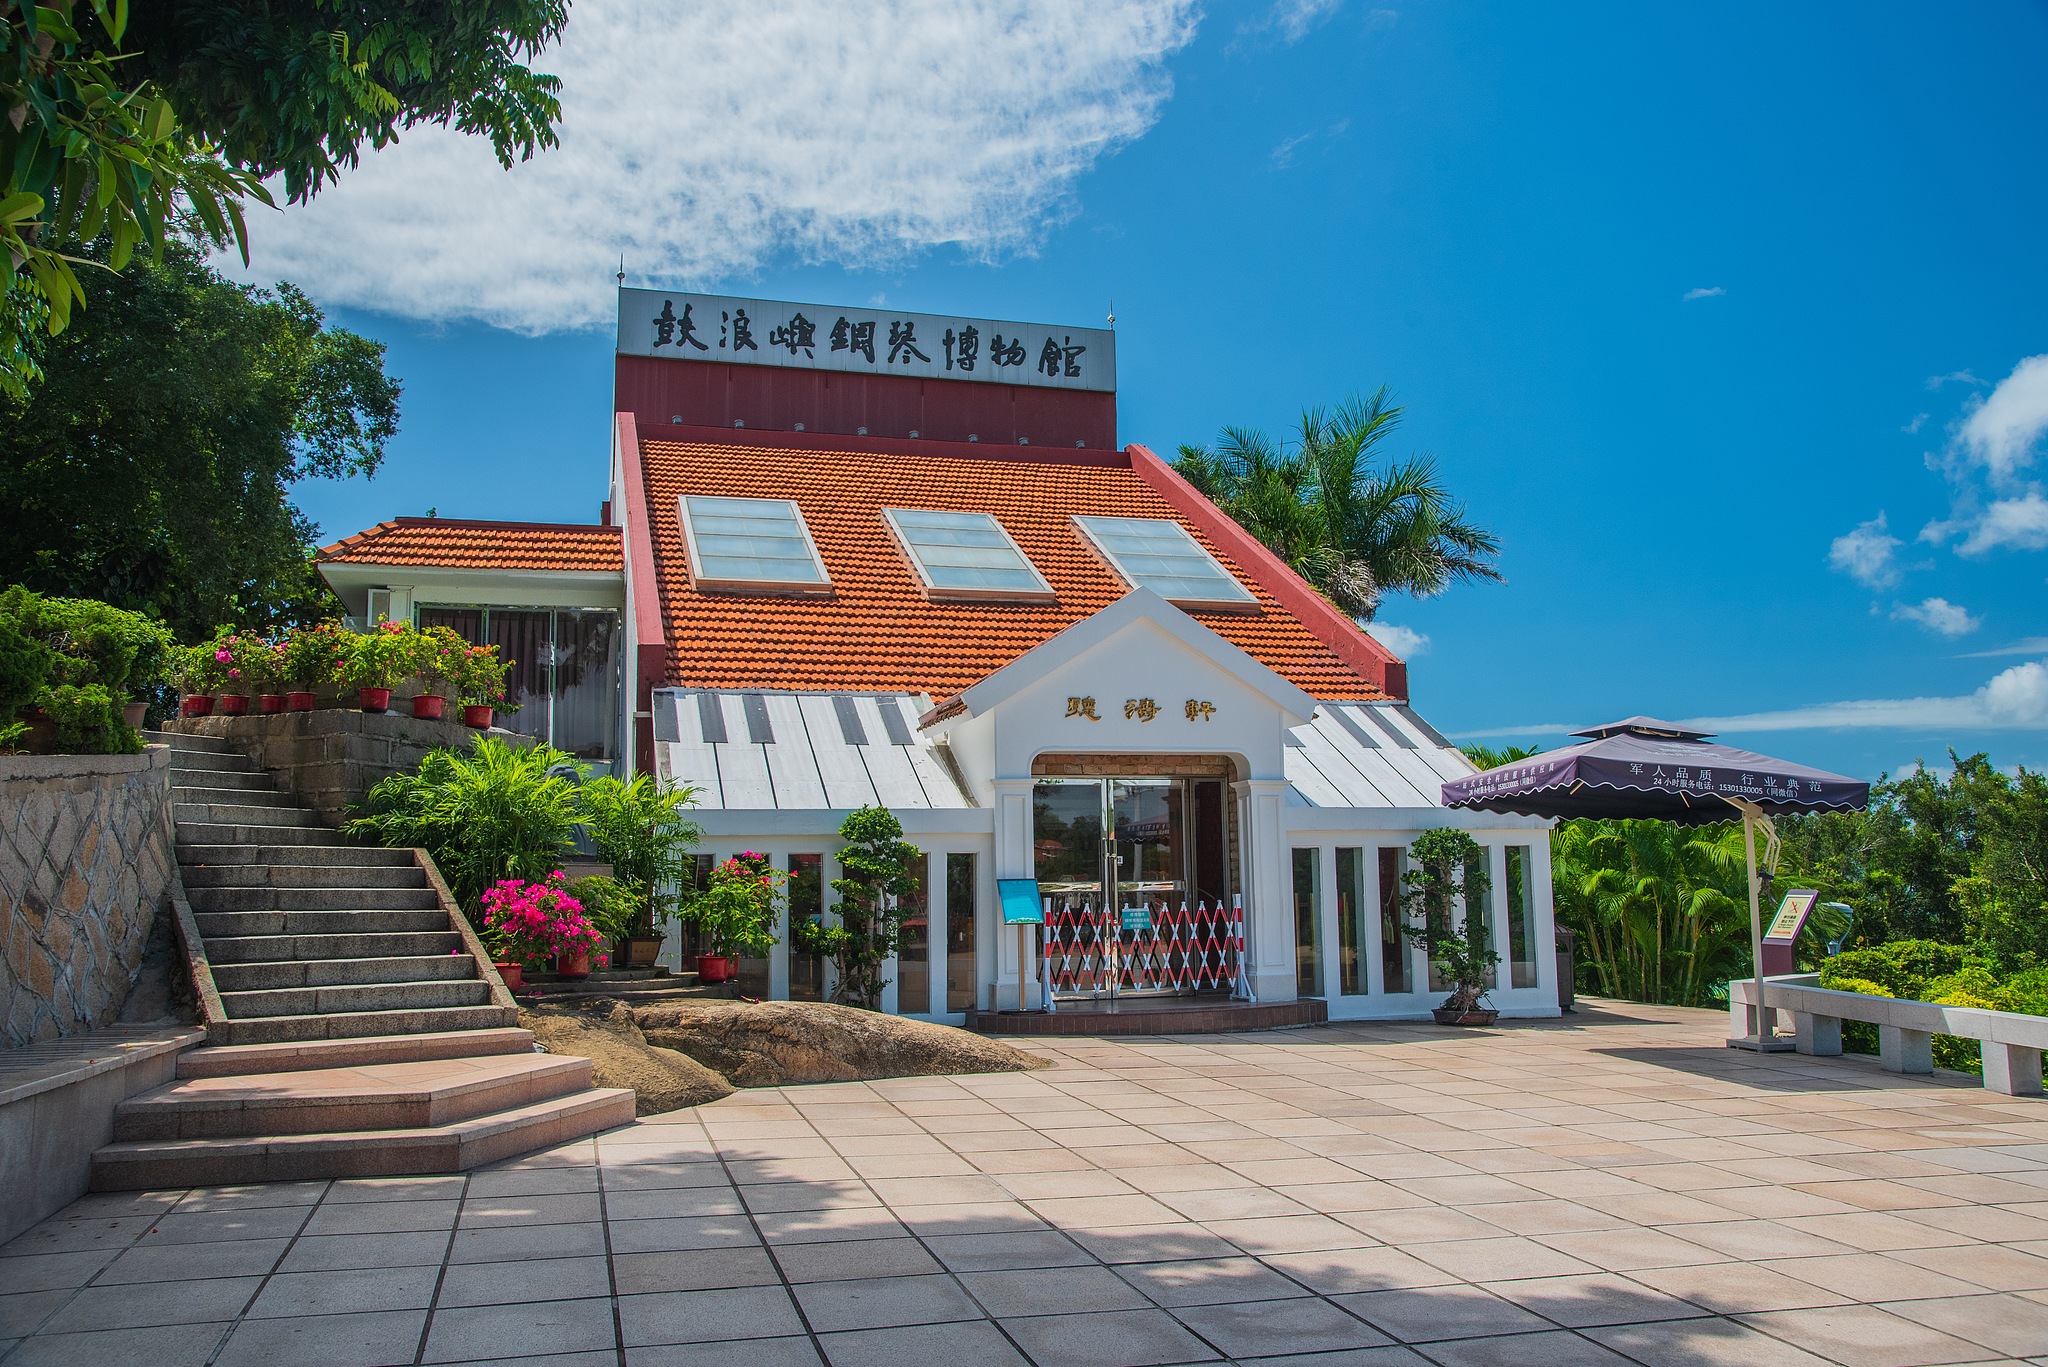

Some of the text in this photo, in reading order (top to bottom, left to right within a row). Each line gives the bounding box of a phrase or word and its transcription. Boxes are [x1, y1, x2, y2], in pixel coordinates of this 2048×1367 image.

[652, 299, 1087, 378] 鼓浪嶼鋼琴博物館
[1629, 762, 1823, 793] 军人品质 行业典范
[1653, 778, 1662, 786] 24
